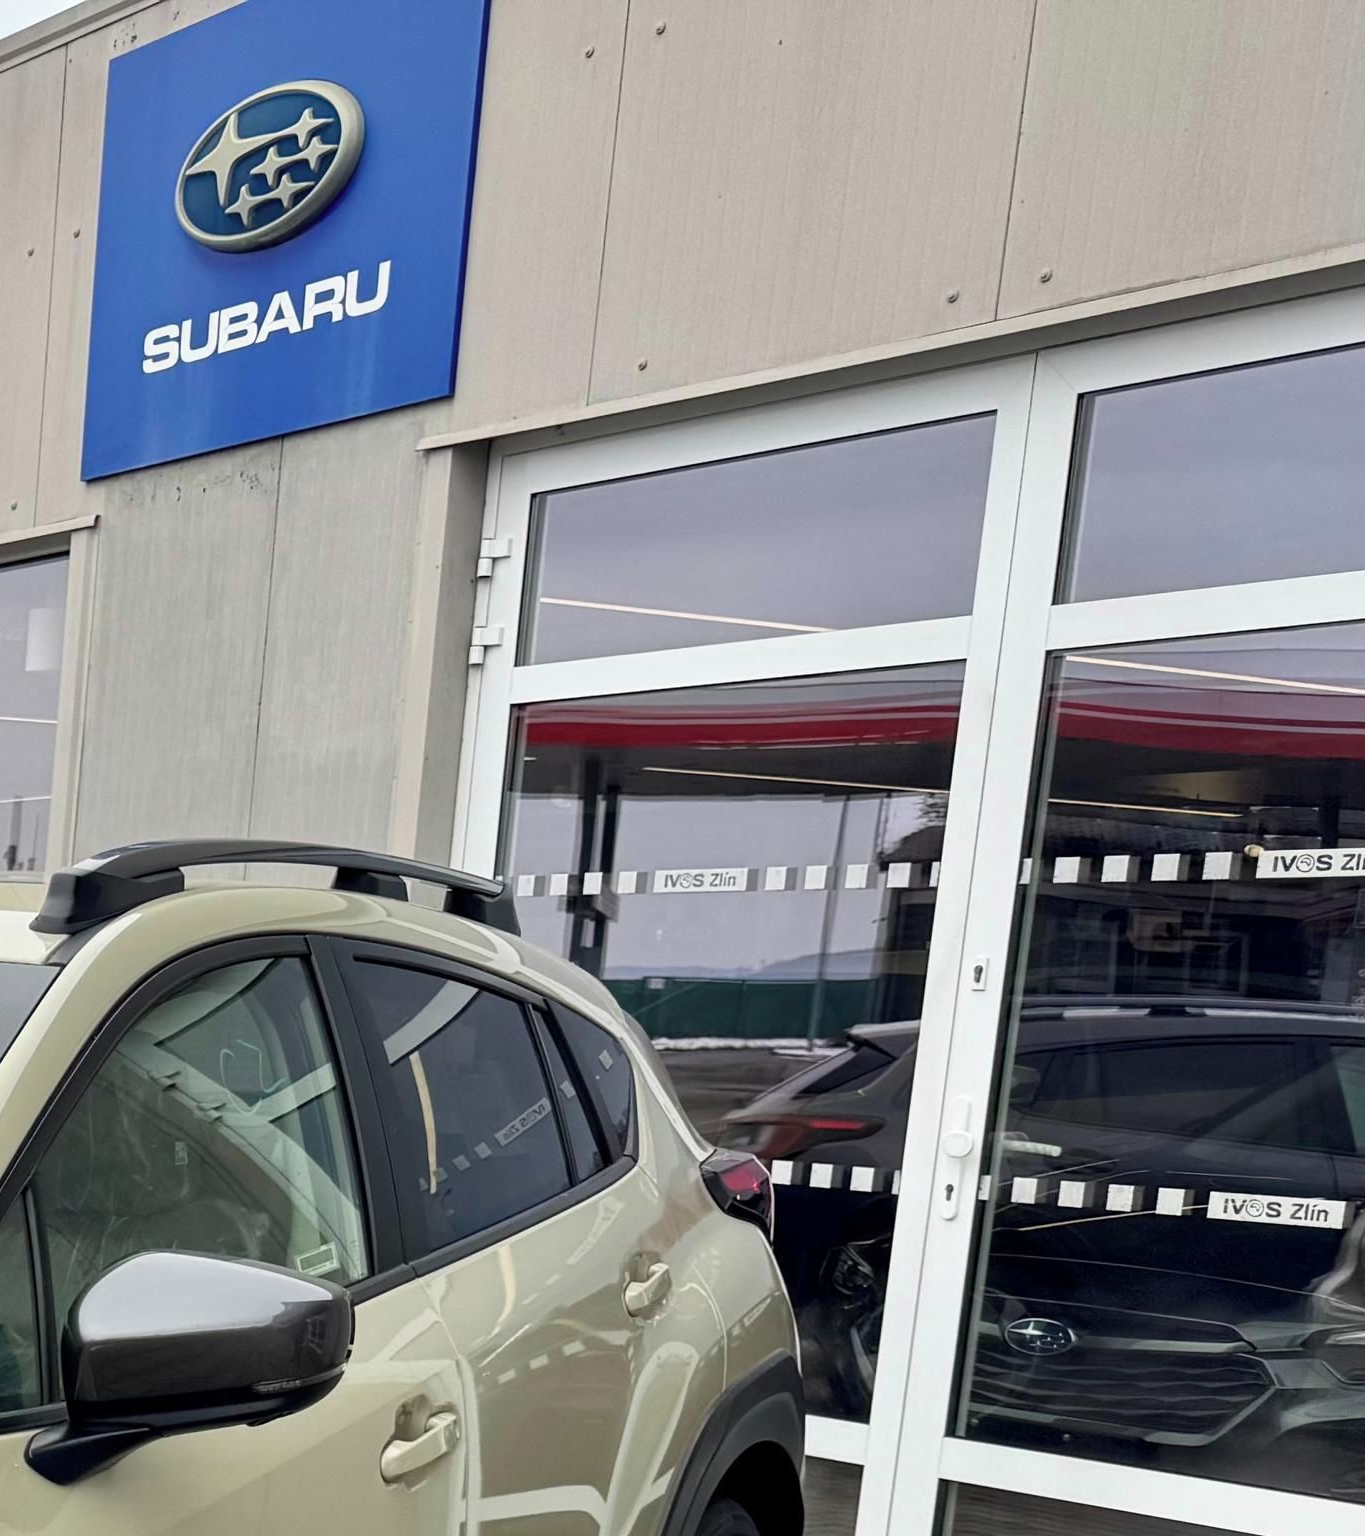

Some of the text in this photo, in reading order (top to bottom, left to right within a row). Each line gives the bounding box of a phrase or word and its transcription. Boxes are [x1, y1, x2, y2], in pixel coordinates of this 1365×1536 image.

[142, 260, 391, 374] SUBARU
[708, 871, 737, 888] Zlín
[1289, 1203, 1329, 1223] Zlín
